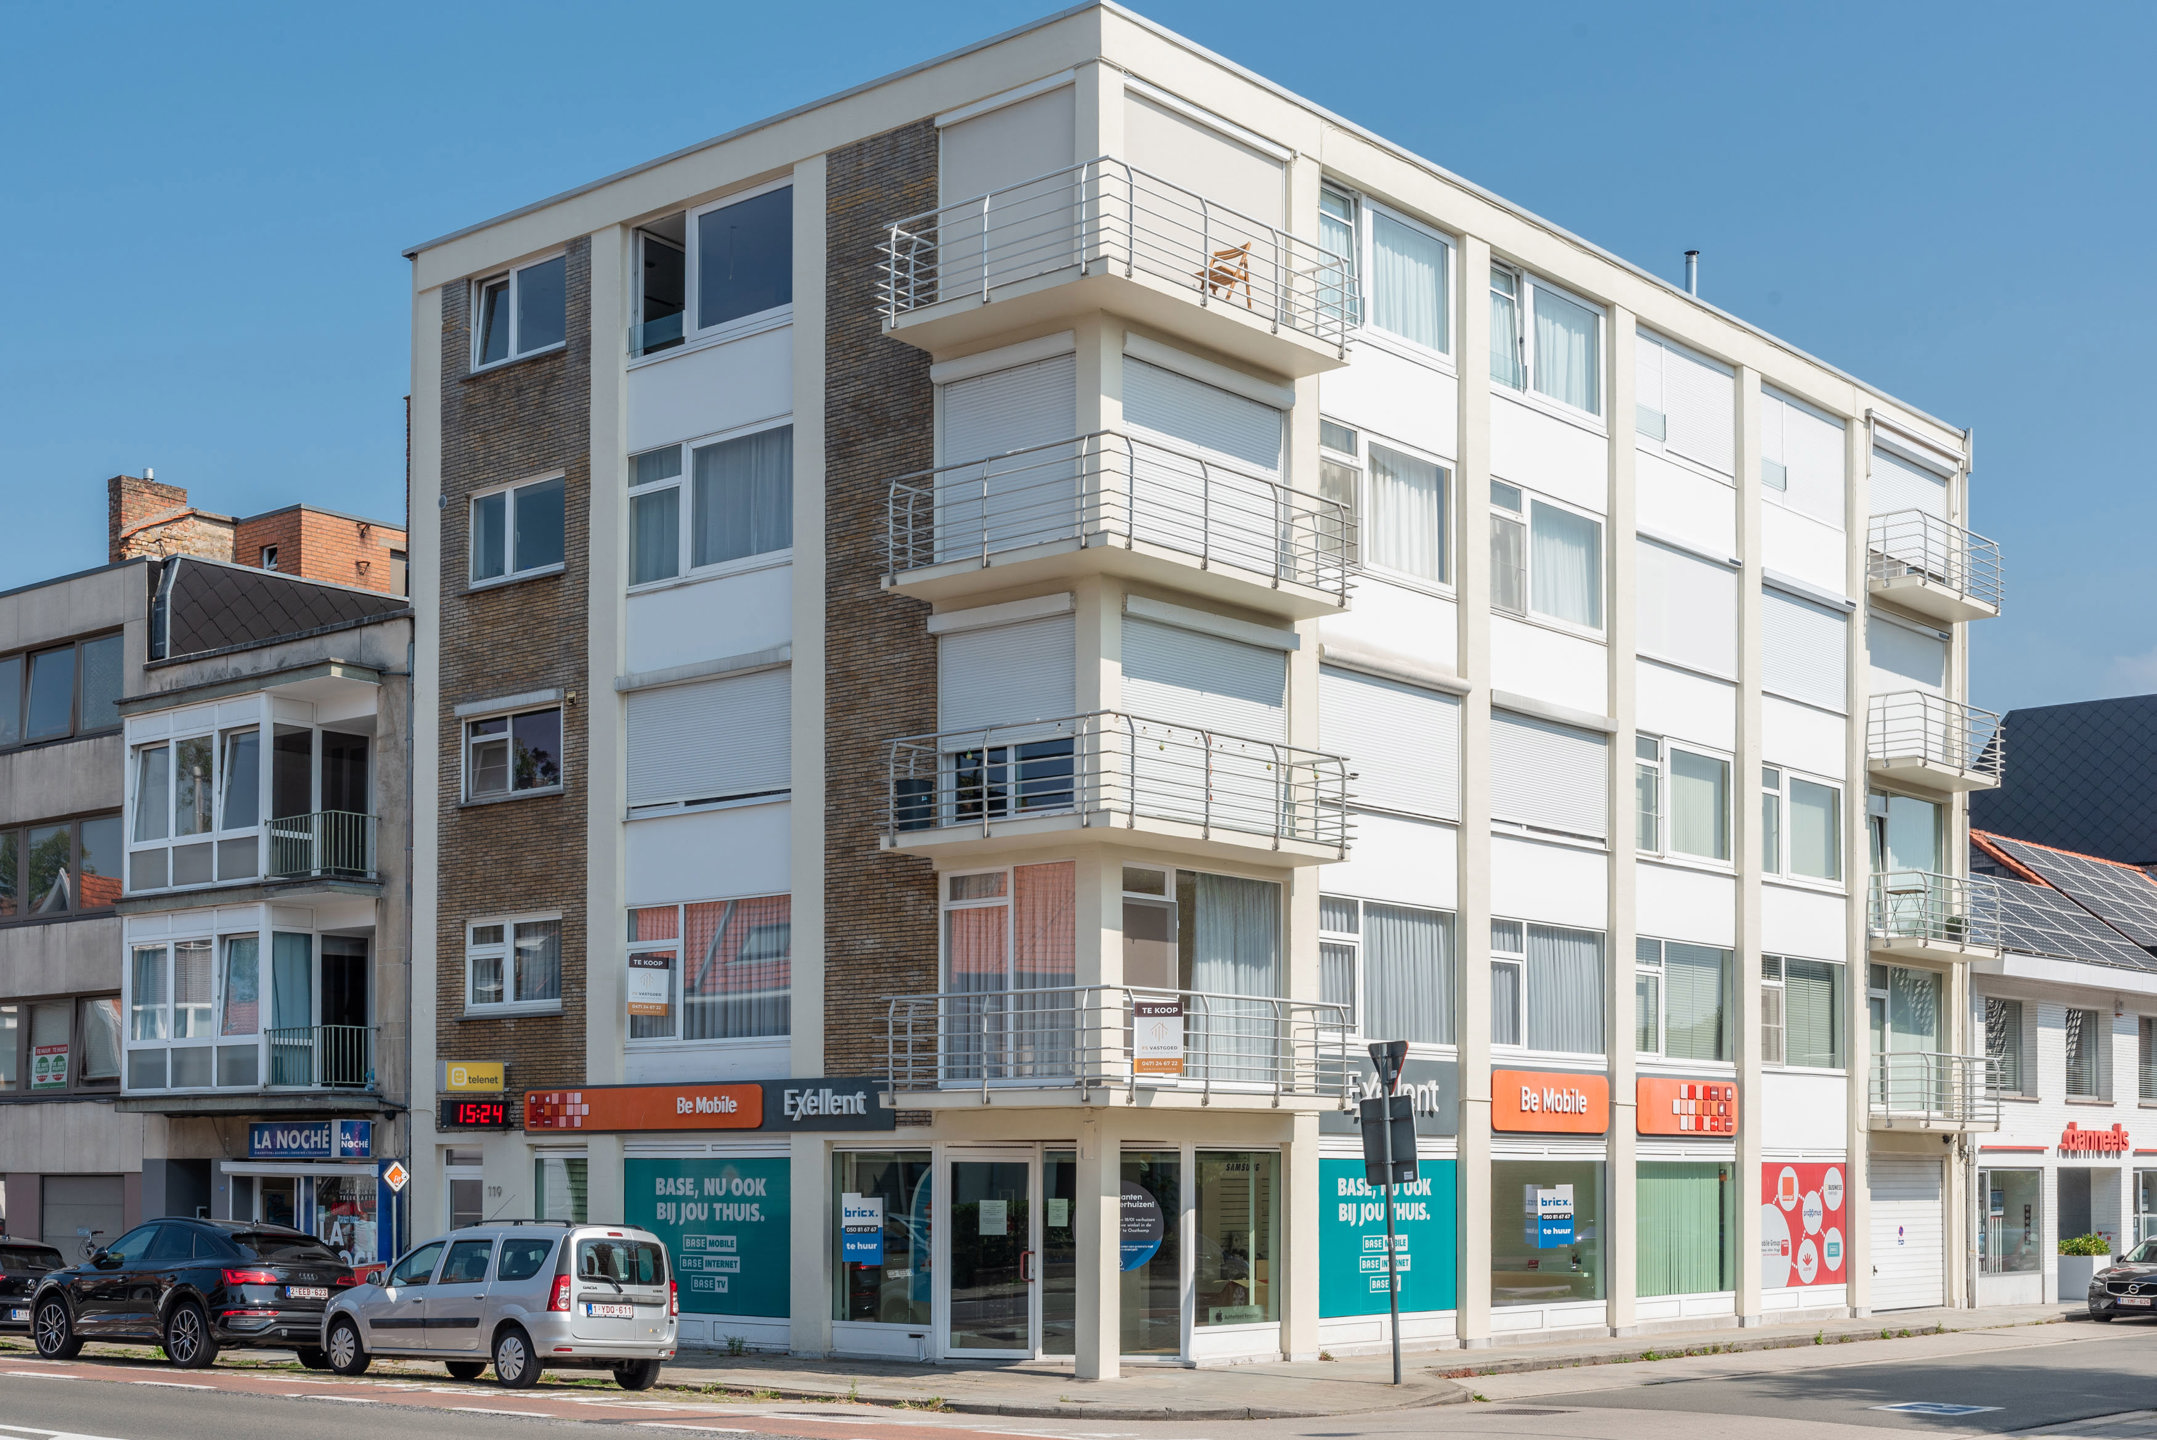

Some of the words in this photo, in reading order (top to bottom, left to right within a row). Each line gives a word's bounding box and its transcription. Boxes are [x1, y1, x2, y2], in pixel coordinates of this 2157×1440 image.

[468, 1075, 499, 1084] telenet
[676, 1096, 693, 1115] Be
[695, 1095, 738, 1114] Mobile
[1520, 1086, 1540, 1113] Be
[1541, 1088, 1588, 1115] Mobile
[459, 1104, 503, 1124] 15:24
[254, 1131, 272, 1149] LA
[276, 1124, 330, 1149] NOCHÉ
[341, 1132, 351, 1140] LA
[341, 1139, 369, 1148] NOCHÉ
[1226, 1163, 1260, 1171] SAMSUG
[488, 1185, 502, 1198] 119
[656, 1178, 699, 1199] BASE,
[704, 1178, 727, 1197] NU
[731, 1178, 767, 1197] OOK
[1338, 1178, 1377, 1199] BASE,
[656, 1202, 676, 1225] BIJ
[679, 1202, 709, 1226] JOU
[713, 1203, 765, 1222] THUIS.
[1339, 1203, 1356, 1227] BIJ
[1359, 1203, 1385, 1227] JOU
[1553, 1227, 1572, 1235] huur
[685, 1239, 706, 1248] BASE
[708, 1240, 735, 1249] MOBILE
[846, 1242, 856, 1250] te
[857, 1242, 878, 1250] huur
[1365, 1240, 1383, 1249] BASE
[682, 1258, 702, 1268] BASE
[704, 1260, 739, 1269] INTERNET
[1361, 1260, 1380, 1269] BASE
[693, 1279, 714, 1289] BASE
[716, 1280, 727, 1289] TV
[1372, 1280, 1390, 1289] BASE
